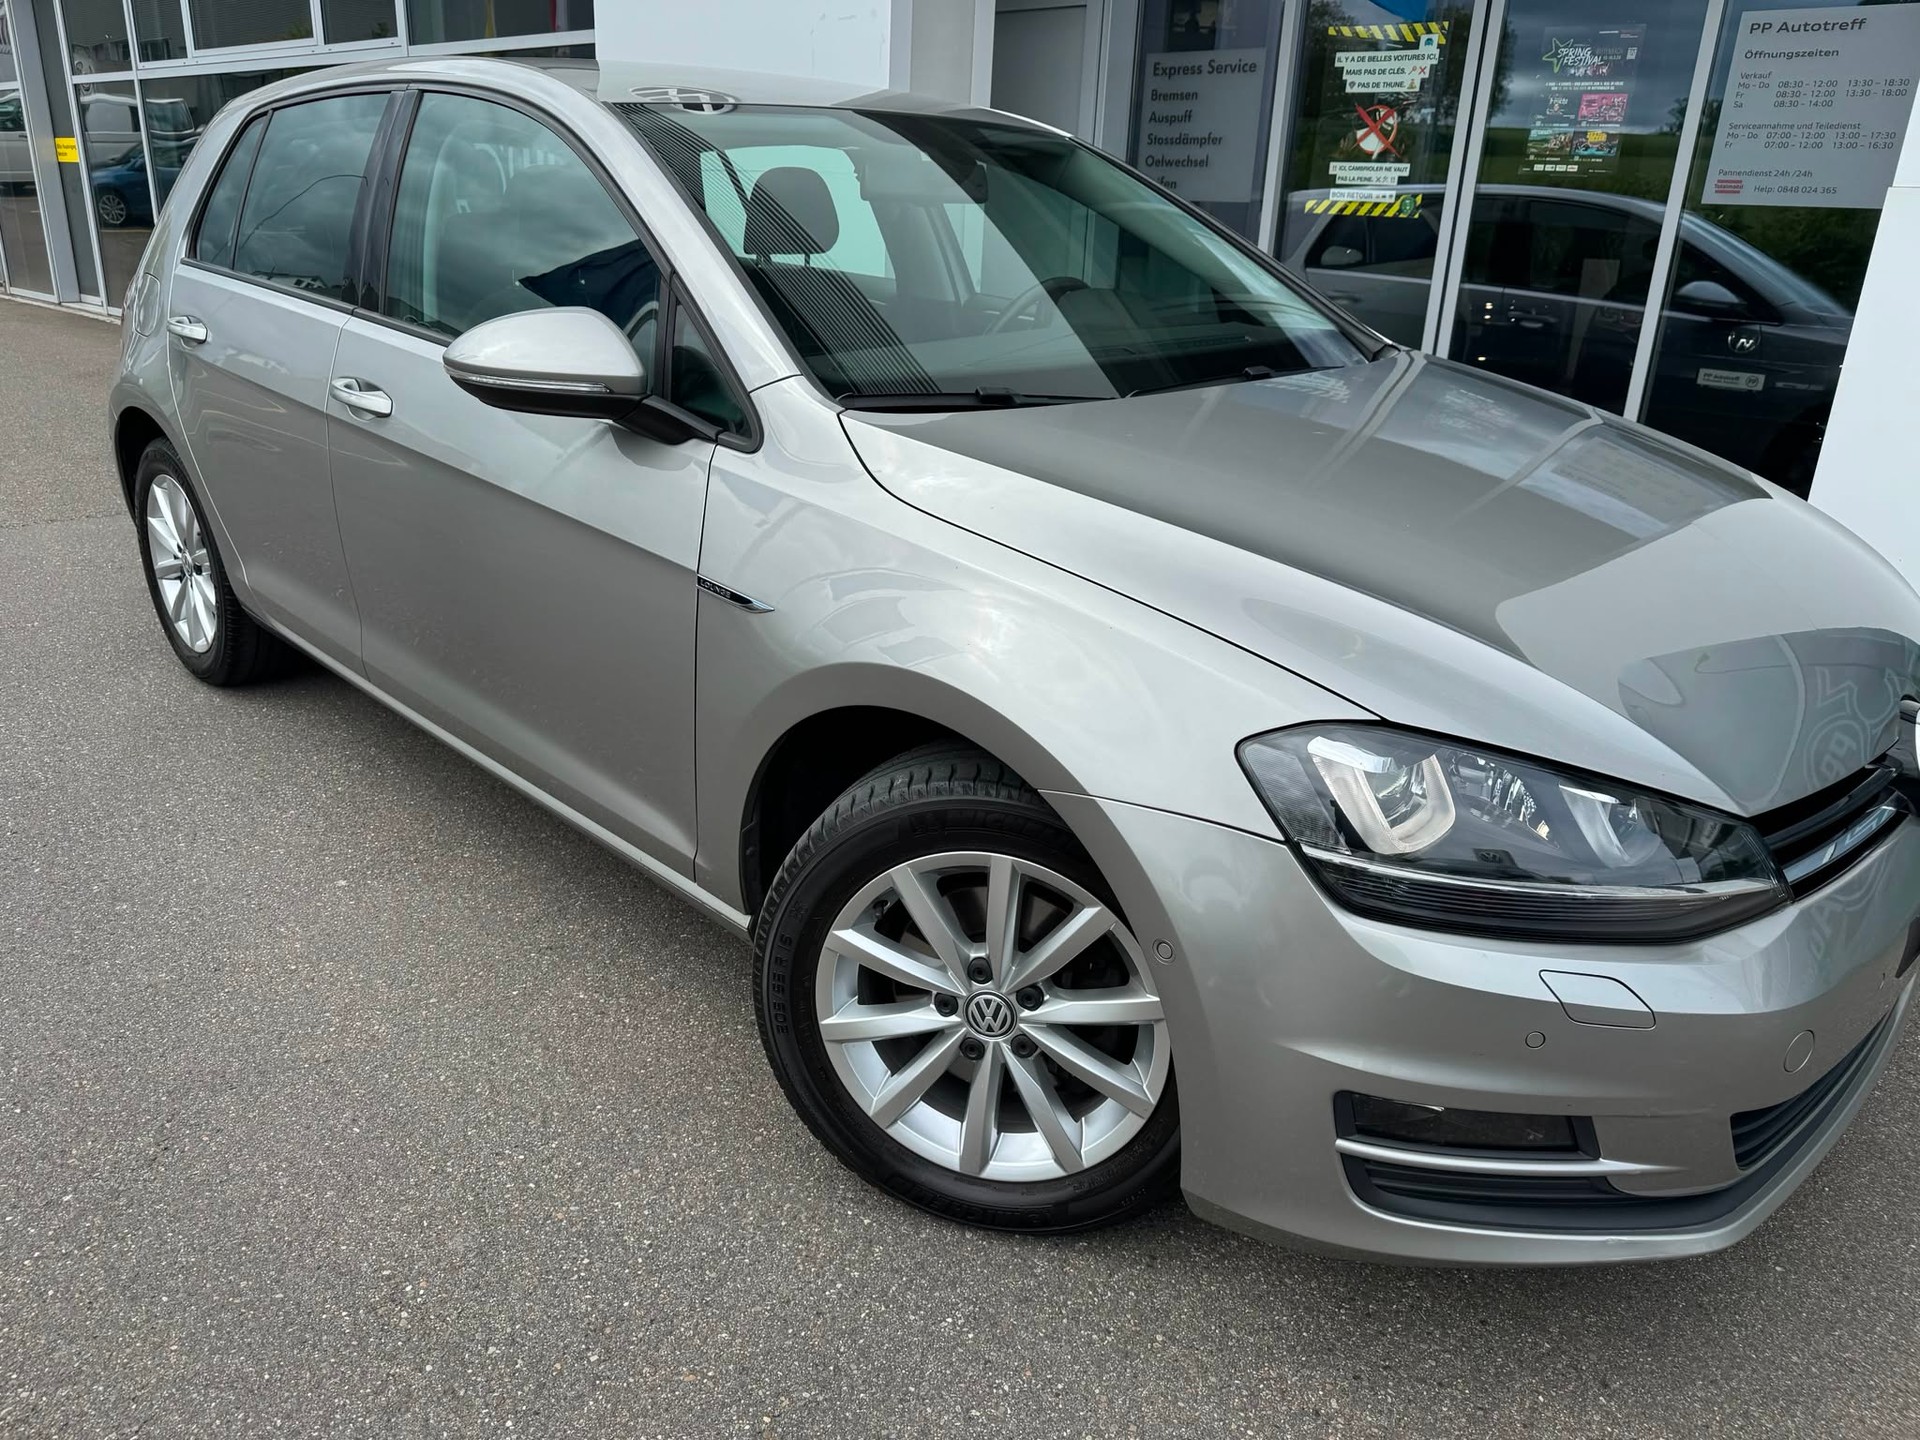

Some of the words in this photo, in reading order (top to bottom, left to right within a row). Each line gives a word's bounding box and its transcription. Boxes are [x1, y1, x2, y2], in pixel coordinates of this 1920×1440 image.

[1750, 22, 1772, 34] PP
[1776, 18, 1867, 34] Autotreff
[1557, 47, 1592, 58] SPRING
[1744, 48, 1840, 60] Öffnungszeiten
[1563, 55, 1604, 66] FESTIVAL
[1153, 61, 1203, 80] Express
[1207, 59, 1257, 75] Service
[1740, 71, 1773, 80] Verkauf
[1737, 81, 1751, 89] Mo
[1758, 81, 1770, 89] Do
[1778, 81, 1804, 89] 08:30
[1813, 80, 1838, 88] 12:00
[1848, 79, 1873, 87] 13:30
[1883, 78, 1910, 87] 18:30
[1151, 88, 1199, 101] Bremsen
[1776, 90, 1801, 98] 08:30
[1810, 90, 1836, 98] 12:00
[1845, 89, 1871, 97] 13:30
[1881, 88, 1908, 97] 18:00
[1733, 101, 1743, 109] Sa
[1773, 100, 1799, 108] 08:30
[1808, 100, 1833, 108] 14:00
[1148, 109, 1193, 126] Auspuff
[1728, 122, 1795, 130] Serviceannahme
[1797, 122, 1813, 130] und
[1815, 122, 1861, 130] Teiledienst
[1146, 131, 1223, 148] Stossdämpfer
[1766, 131, 1791, 139] 07:00
[1800, 131, 1826, 139] 12:00
[1835, 131, 1860, 139] 13:00
[1870, 131, 1896, 140] 17:30
[1764, 141, 1789, 149] 07:00
[1798, 141, 1823, 149] 12:00
[1832, 141, 1858, 149] 13:00
[1868, 141, 1894, 150] 16:30
[1145, 154, 1209, 168] Oelwechsel
[1718, 169, 1772, 177] Pannendienst
[1773, 169, 1791, 177] 24h
[1753, 185, 1776, 194] Help:
[1777, 185, 1800, 194] 0848
[1800, 185, 1818, 194] 024
[1820, 185, 1838, 194] 365
[699, 579, 732, 599] LOUNGE
[968, 995, 1012, 1036] VW
